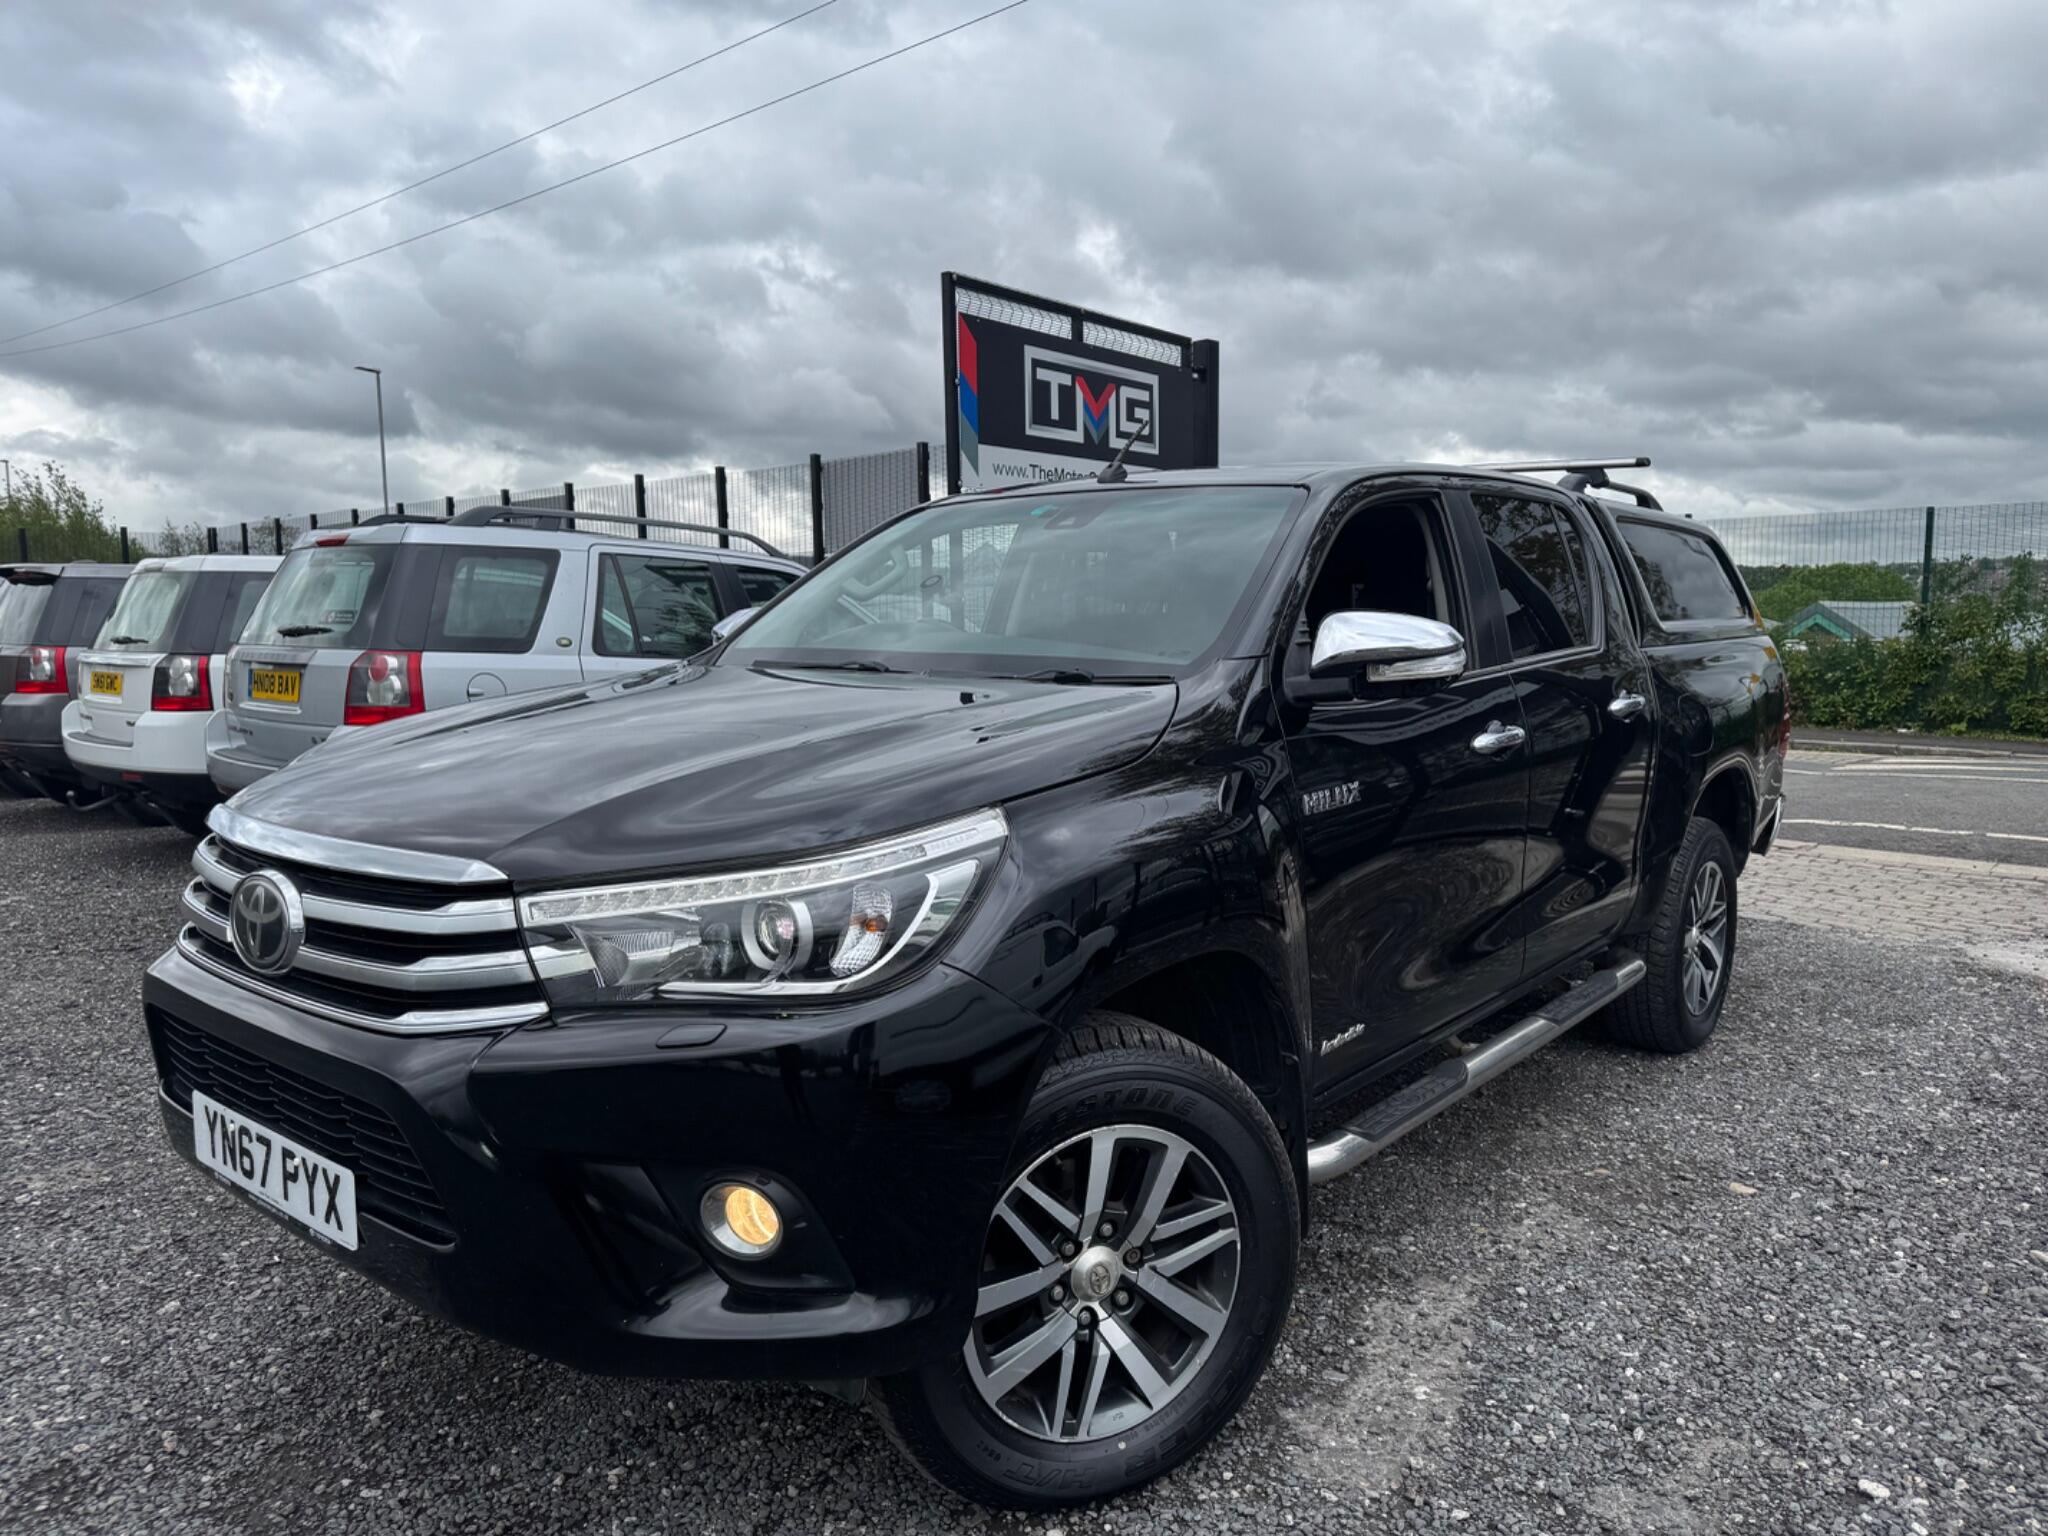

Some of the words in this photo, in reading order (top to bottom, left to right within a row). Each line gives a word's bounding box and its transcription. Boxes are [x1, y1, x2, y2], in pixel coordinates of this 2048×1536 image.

[1036, 367, 1150, 446] TMG
[278, 674, 297, 697] BAV
[1303, 780, 1361, 815] HILUX
[204, 1104, 272, 1188] YN67
[281, 1145, 343, 1233] PYX
